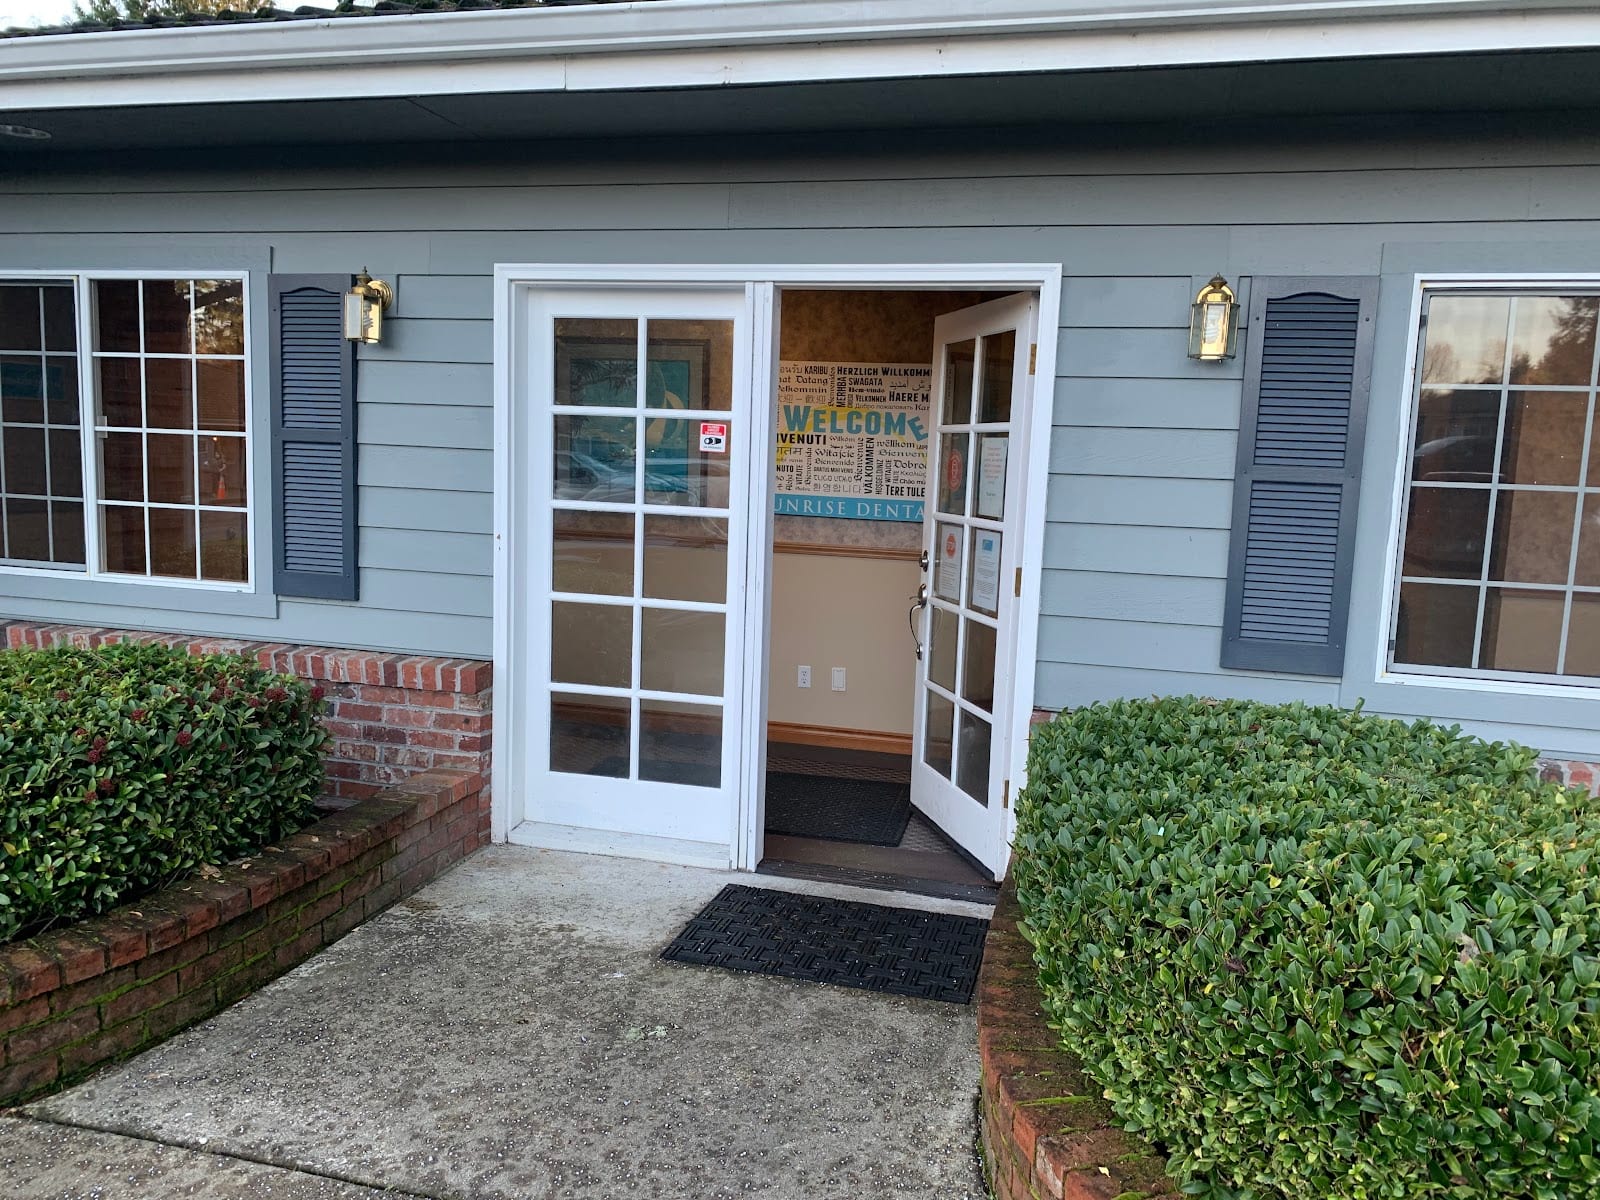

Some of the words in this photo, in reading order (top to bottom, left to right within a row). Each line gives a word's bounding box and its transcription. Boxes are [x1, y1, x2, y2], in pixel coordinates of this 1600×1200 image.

[804, 365, 828, 375] KARIBU
[836, 366, 879, 377] HERZLICH
[795, 375, 827, 386] Datang
[848, 377, 883, 386] SWAGATA
[836, 377, 847, 407] MERHBA
[889, 391, 919, 402] HAERE
[856, 394, 887, 403] VELKOMMEN
[783, 405, 928, 442] WELCOME
[863, 437, 875, 494] VÄLKOMMEN
[886, 485, 905, 496] TERE
[907, 486, 926, 498] TULE
